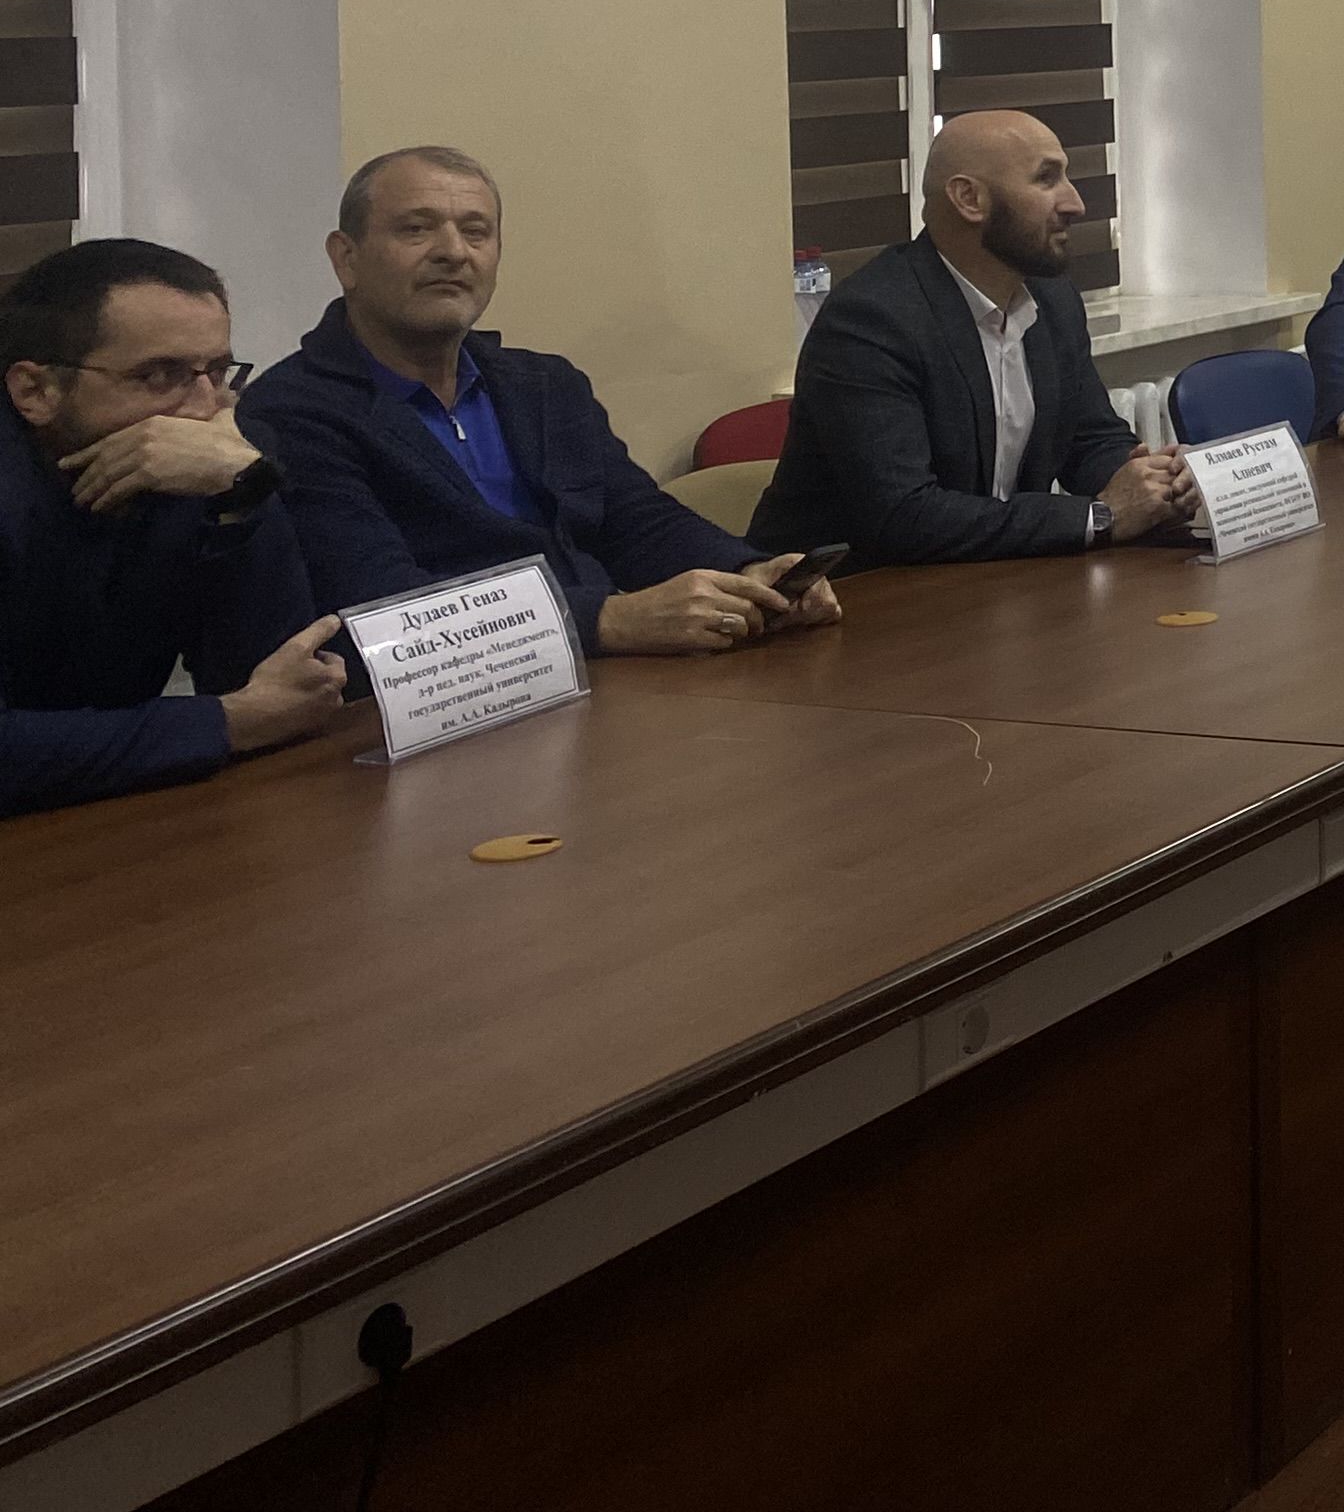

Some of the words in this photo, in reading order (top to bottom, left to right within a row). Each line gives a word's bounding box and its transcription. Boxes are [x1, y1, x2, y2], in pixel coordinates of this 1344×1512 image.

[401, 602, 460, 633] Дудаев
[462, 586, 508, 612] Геназ
[391, 607, 537, 663] Сайд-Хусейнович
[383, 663, 440, 690] Профессор
[440, 648, 486, 672] кафедры
[485, 649, 538, 675] Чеченский
[407, 681, 496, 721] государственный
[496, 663, 555, 692] университет
[483, 691, 533, 717] Кадырова
